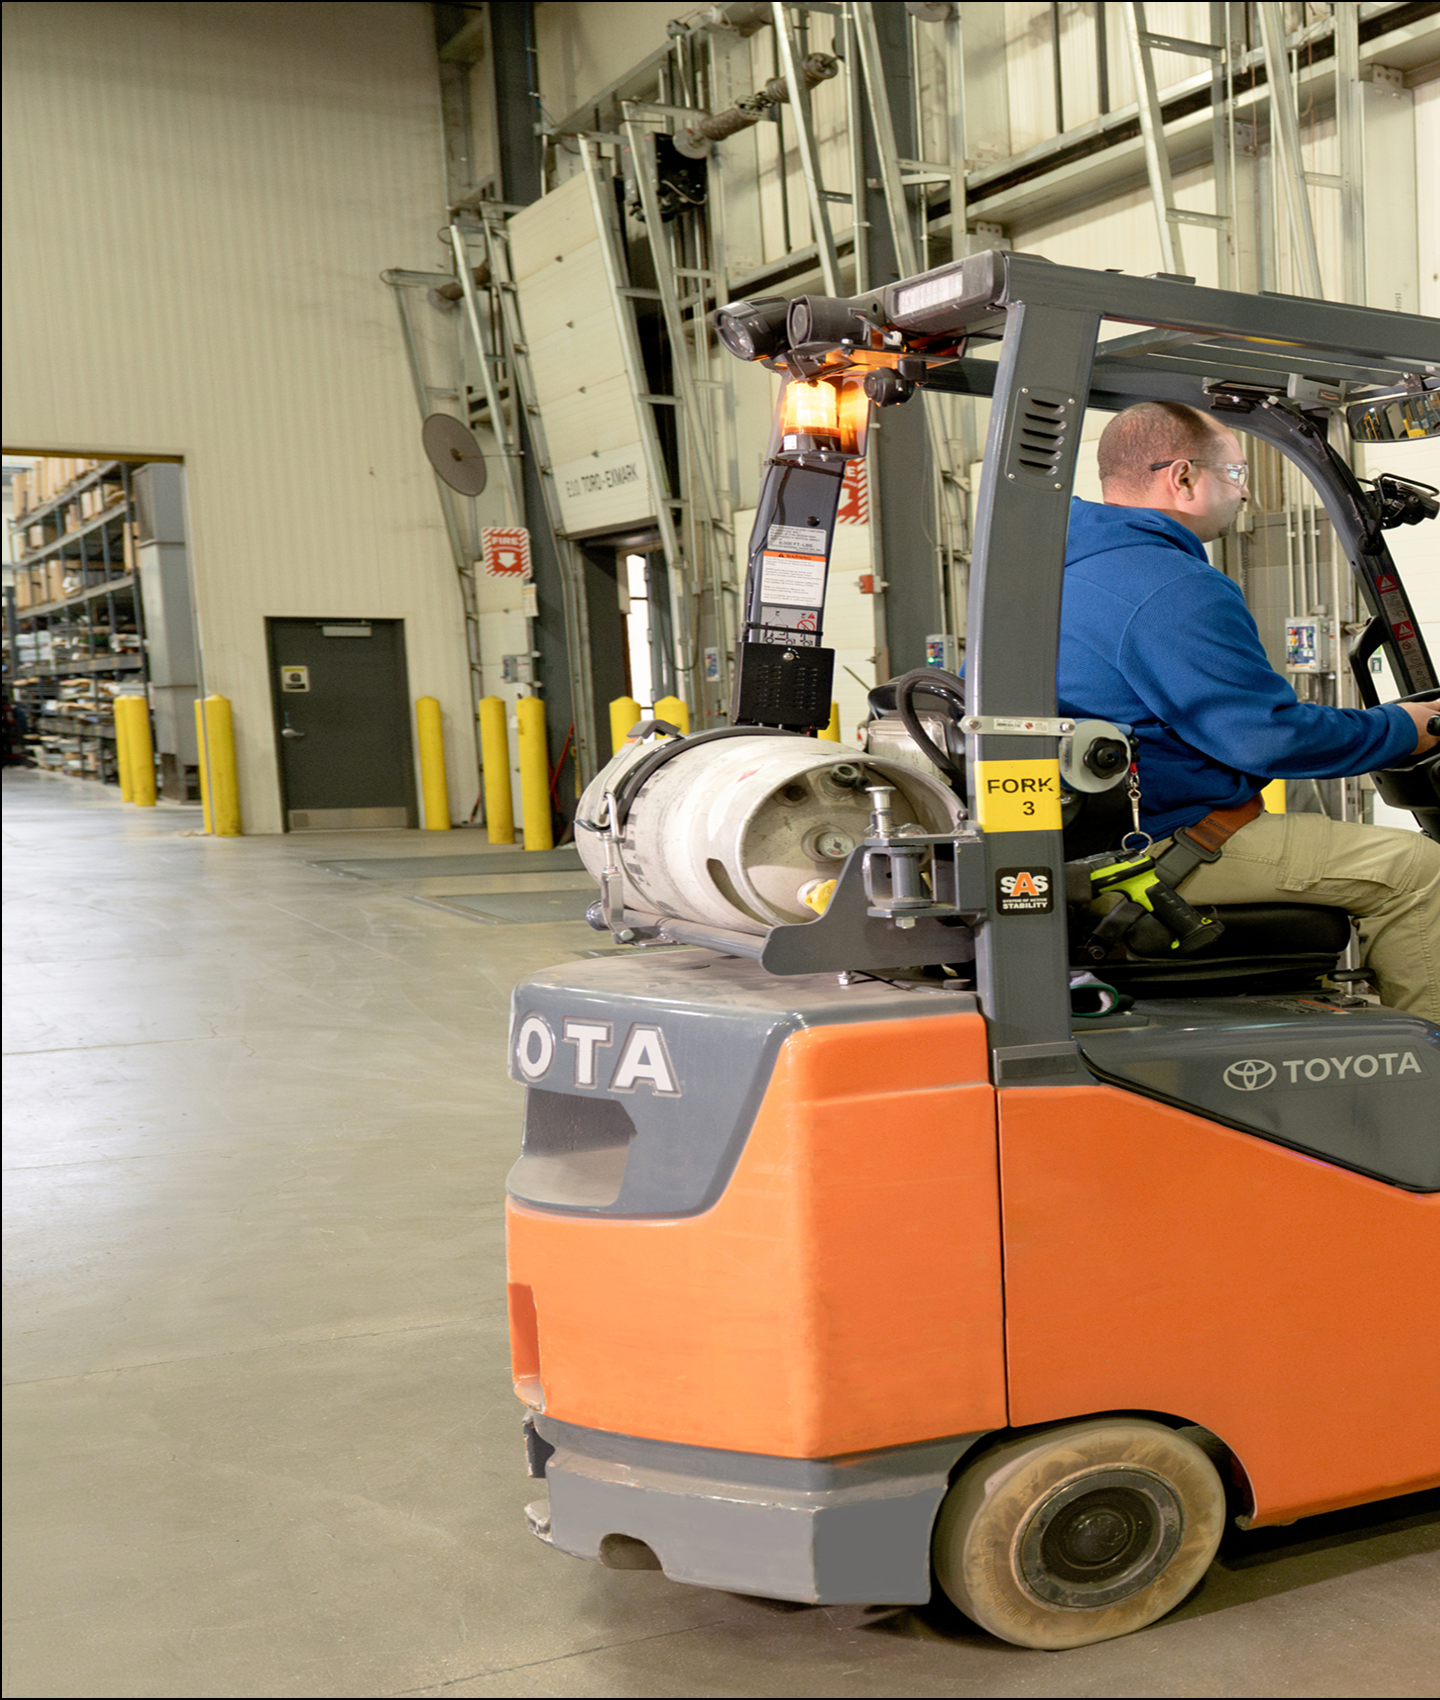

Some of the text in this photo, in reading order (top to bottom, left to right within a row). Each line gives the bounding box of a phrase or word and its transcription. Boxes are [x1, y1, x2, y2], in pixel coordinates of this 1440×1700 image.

[491, 536, 519, 545] FIRE
[987, 777, 1054, 794] FORK
[1022, 801, 1035, 816] 3
[1000, 871, 1049, 896] SAS
[1282, 1051, 1422, 1083] TOYOTA
